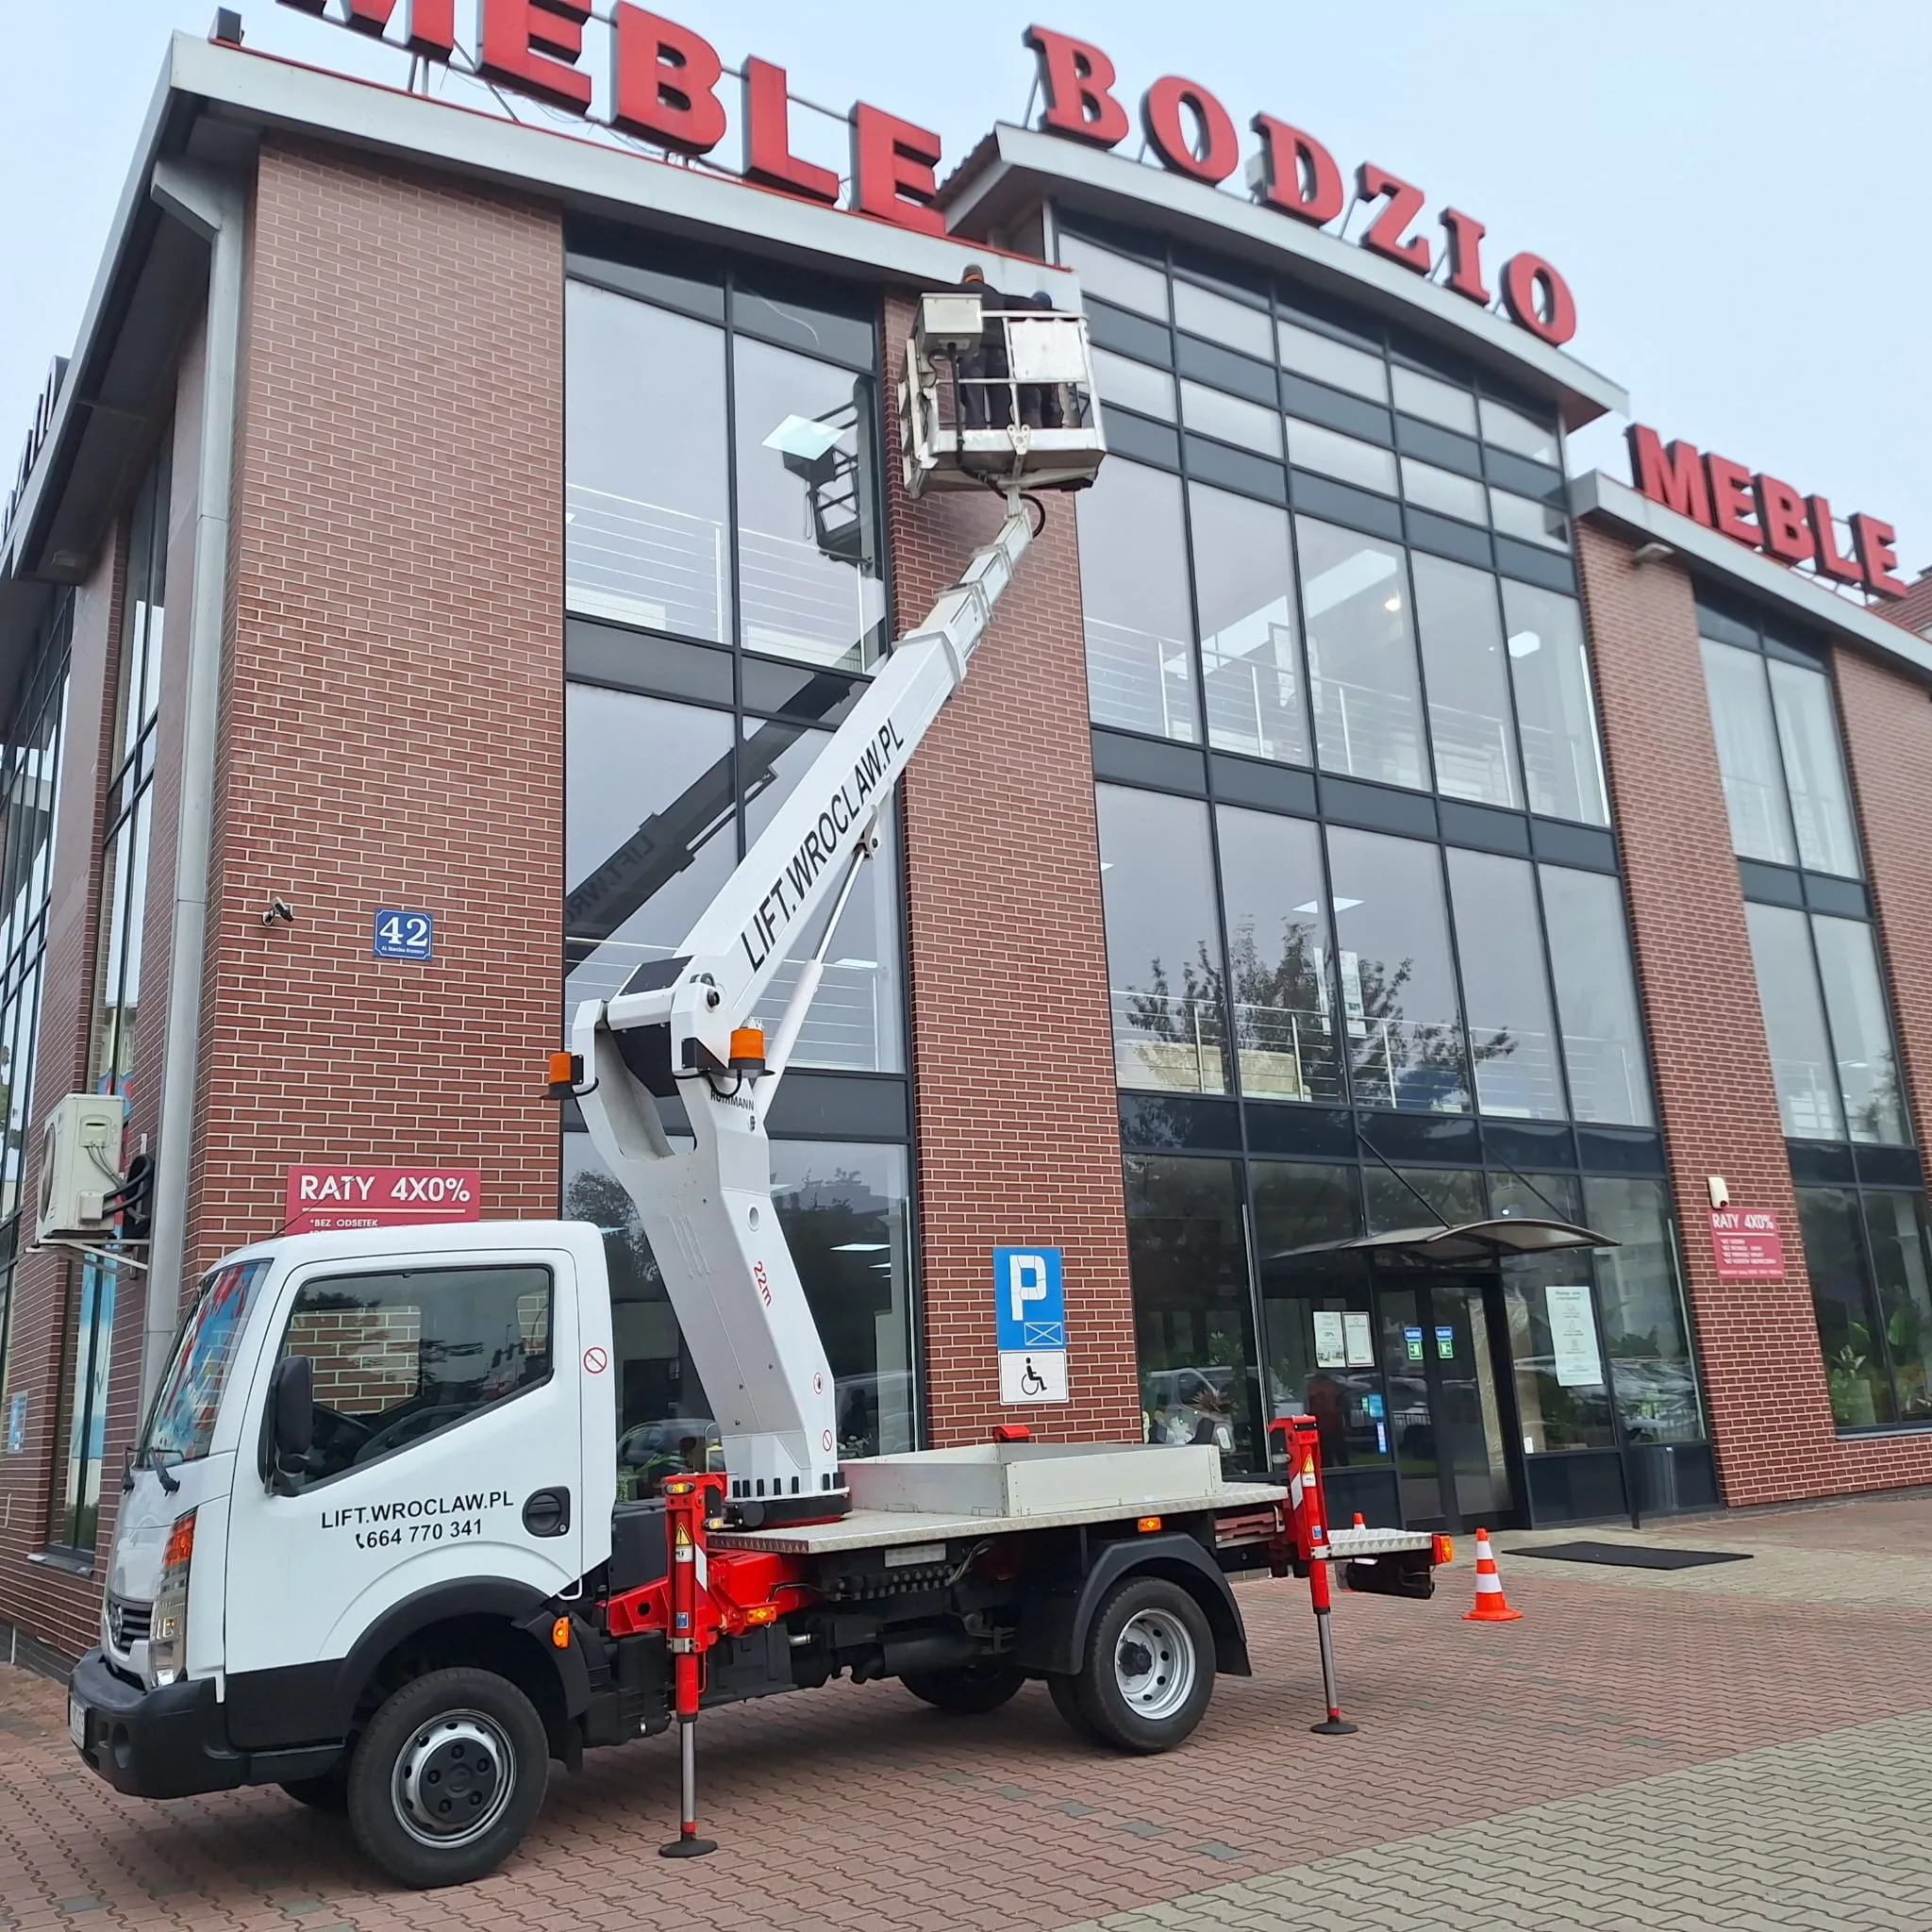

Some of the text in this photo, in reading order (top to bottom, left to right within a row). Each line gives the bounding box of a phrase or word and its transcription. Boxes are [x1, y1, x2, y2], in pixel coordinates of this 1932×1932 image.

[1022, 23, 1576, 346] BODZIO
[1623, 422, 1909, 602] MEBLE
[741, 717, 905, 974] LIFT.WROCLAW.PL
[379, 916, 428, 946] 42
[300, 1175, 471, 1202] RATY 4X0%
[336, 1218, 378, 1227] ODSETEK
[1711, 1213, 1740, 1229] RATY
[754, 1260, 772, 1307] 22m
[1009, 1255, 1047, 1321] P
[322, 1491, 513, 1528] LIFT.WROCLAW.PL
[367, 1518, 482, 1549] 664 770 341
